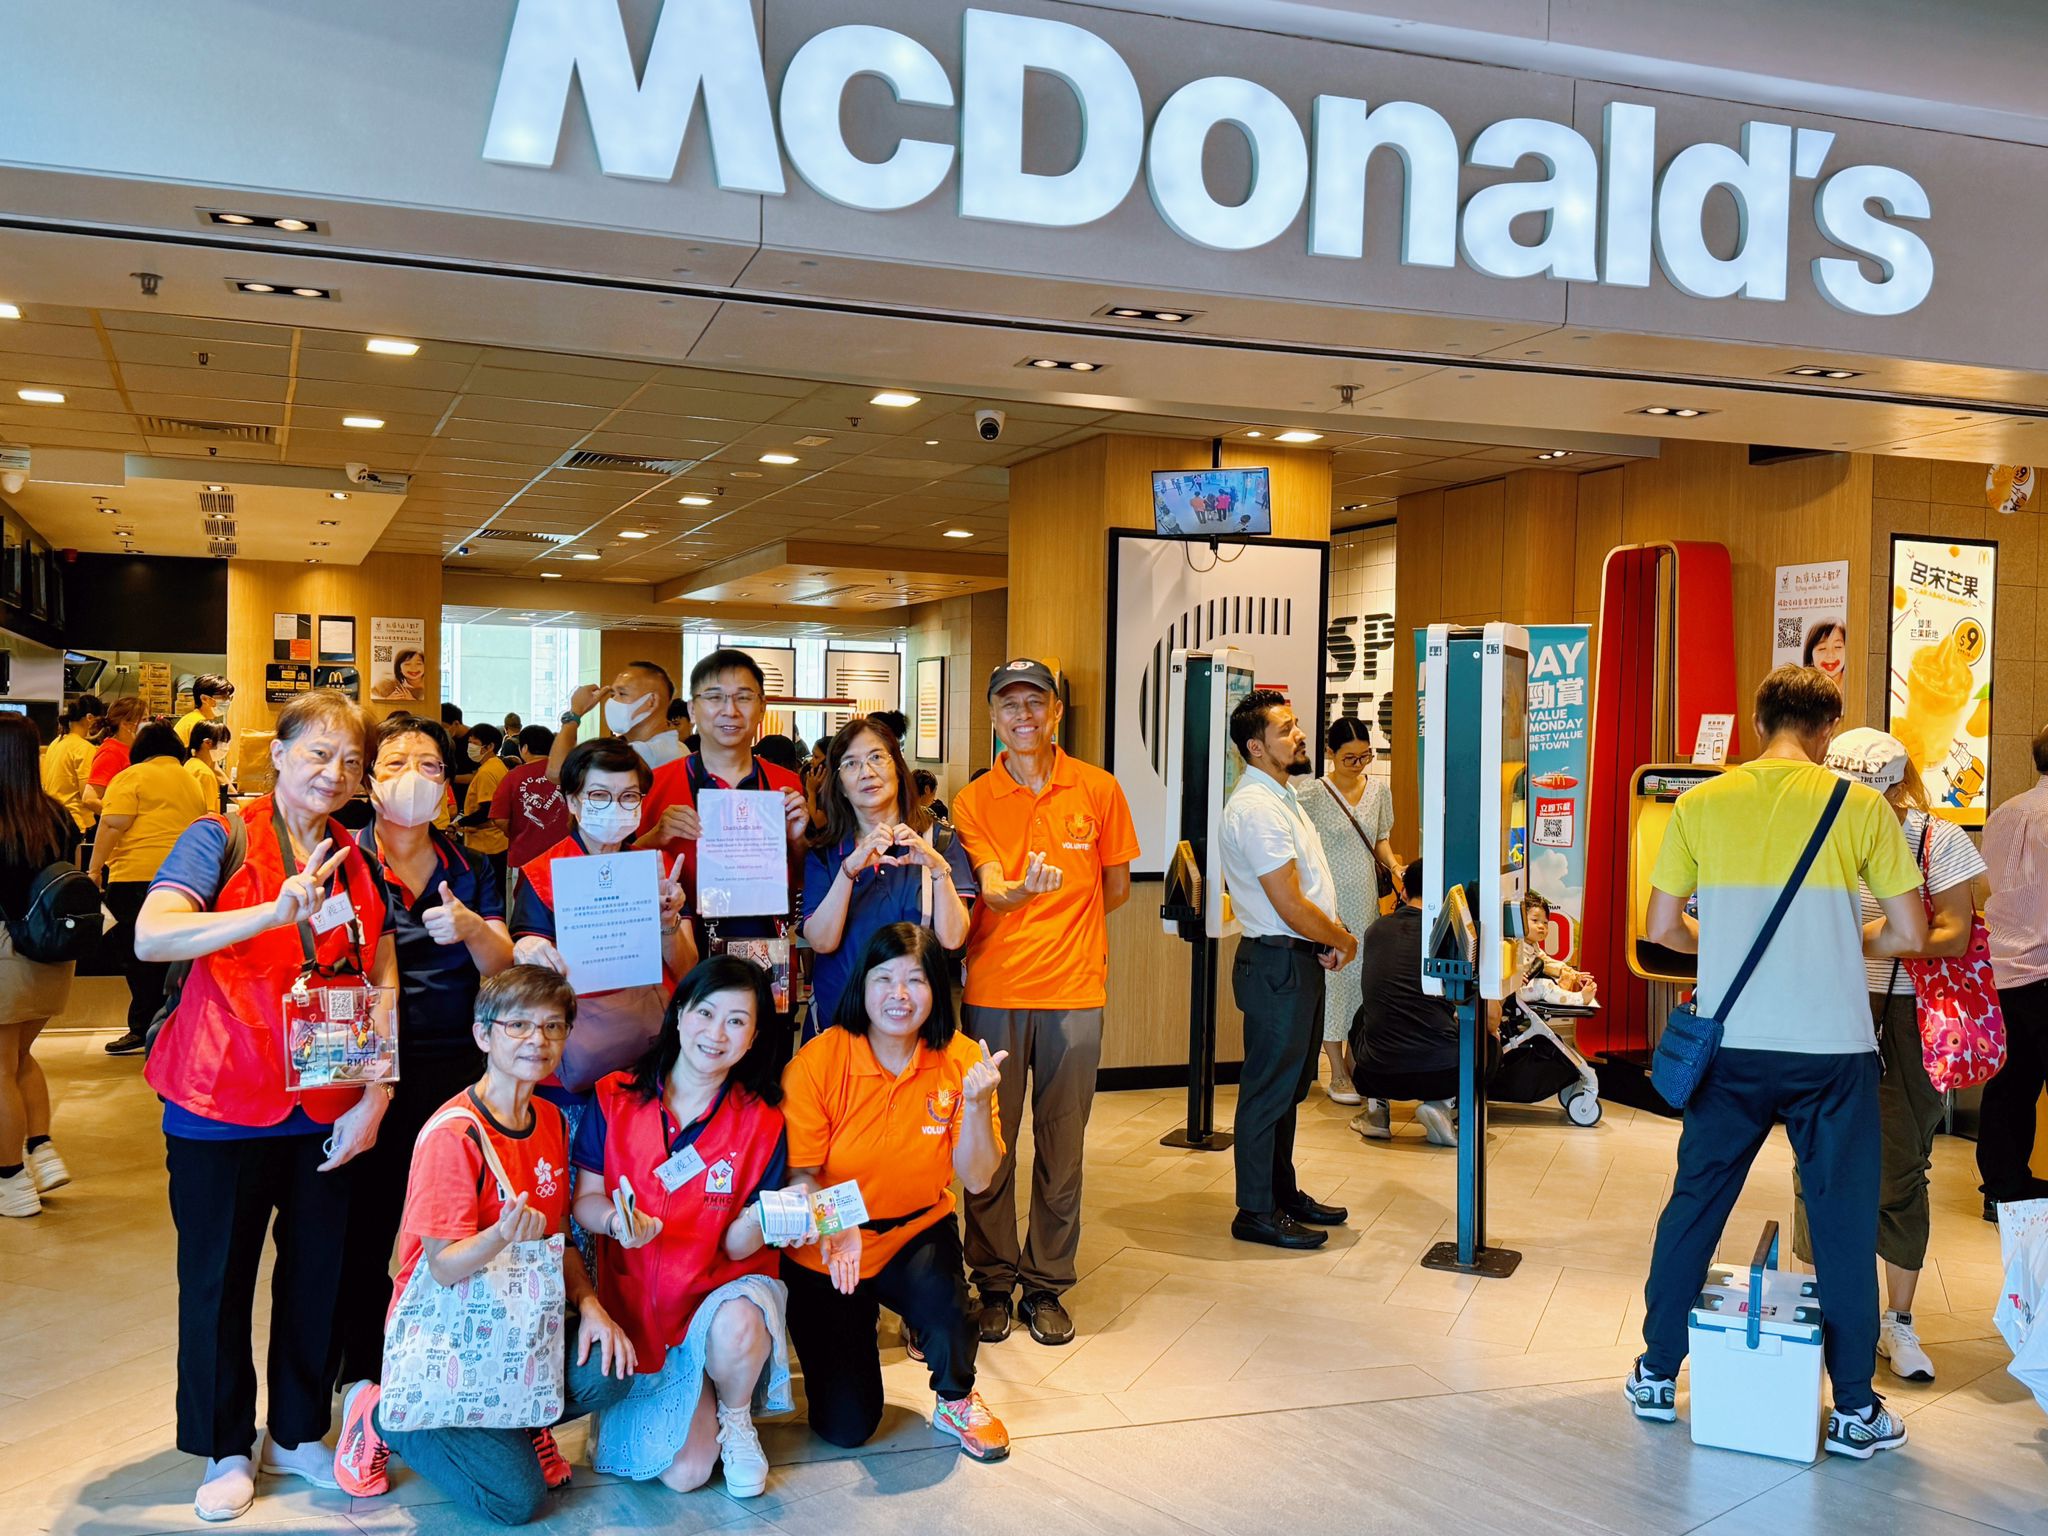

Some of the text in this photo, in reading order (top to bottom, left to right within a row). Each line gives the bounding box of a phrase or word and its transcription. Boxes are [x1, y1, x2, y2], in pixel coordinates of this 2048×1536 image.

[482, 0, 1933, 316] McDonald's
[1910, 561, 1978, 598] 呂宋芒果
[1960, 627, 1979, 651] $9
[1528, 642, 1585, 678] AY
[1529, 709, 1567, 722] VALUE
[1530, 718, 1583, 733] MONDAY
[1529, 730, 1583, 743] BEST VALUE
[1529, 741, 1569, 751] IN TOWN
[347, 1058, 377, 1066] RMHC
